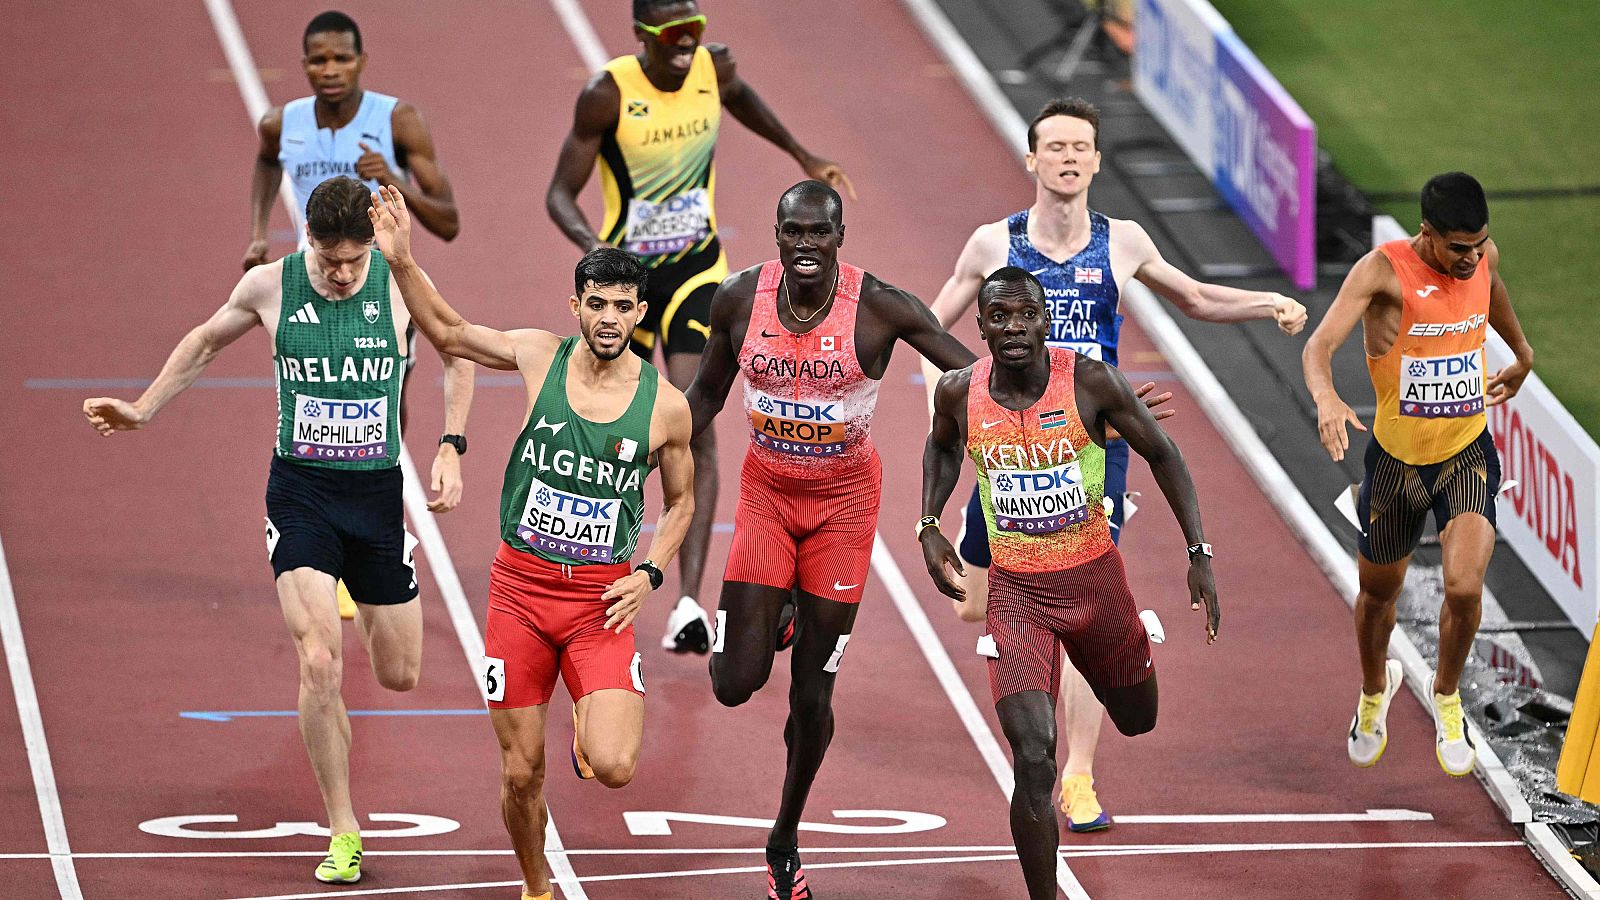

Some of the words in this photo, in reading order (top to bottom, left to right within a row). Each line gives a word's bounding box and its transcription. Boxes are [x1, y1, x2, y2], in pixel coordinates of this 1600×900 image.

[642, 118, 710, 146] JAMAICA
[296, 162, 359, 177] BOTSWA
[632, 213, 708, 238] ANDERSON
[1045, 300, 1096, 320] REAT
[353, 337, 388, 348] 123.ie
[1045, 320, 1097, 340] TAIN
[280, 355, 394, 382] IRELAND
[752, 354, 844, 379] CANADA
[1427, 353, 1477, 377] TDK
[1405, 376, 1480, 401] ATTAOUI
[322, 401, 381, 419] TDK
[773, 400, 836, 421] TDK
[298, 422, 383, 444] McPHILLIPS
[763, 418, 832, 442] AROP
[981, 438, 1077, 469] KENYA
[520, 439, 640, 494] ALGERIA
[1011, 466, 1075, 492] TDK
[552, 491, 614, 519] TDK
[996, 486, 1082, 516] WANYONYI
[1493, 401, 1583, 590] HONDA
[527, 508, 611, 543] SEDJATI
[487, 664, 497, 695] 6
